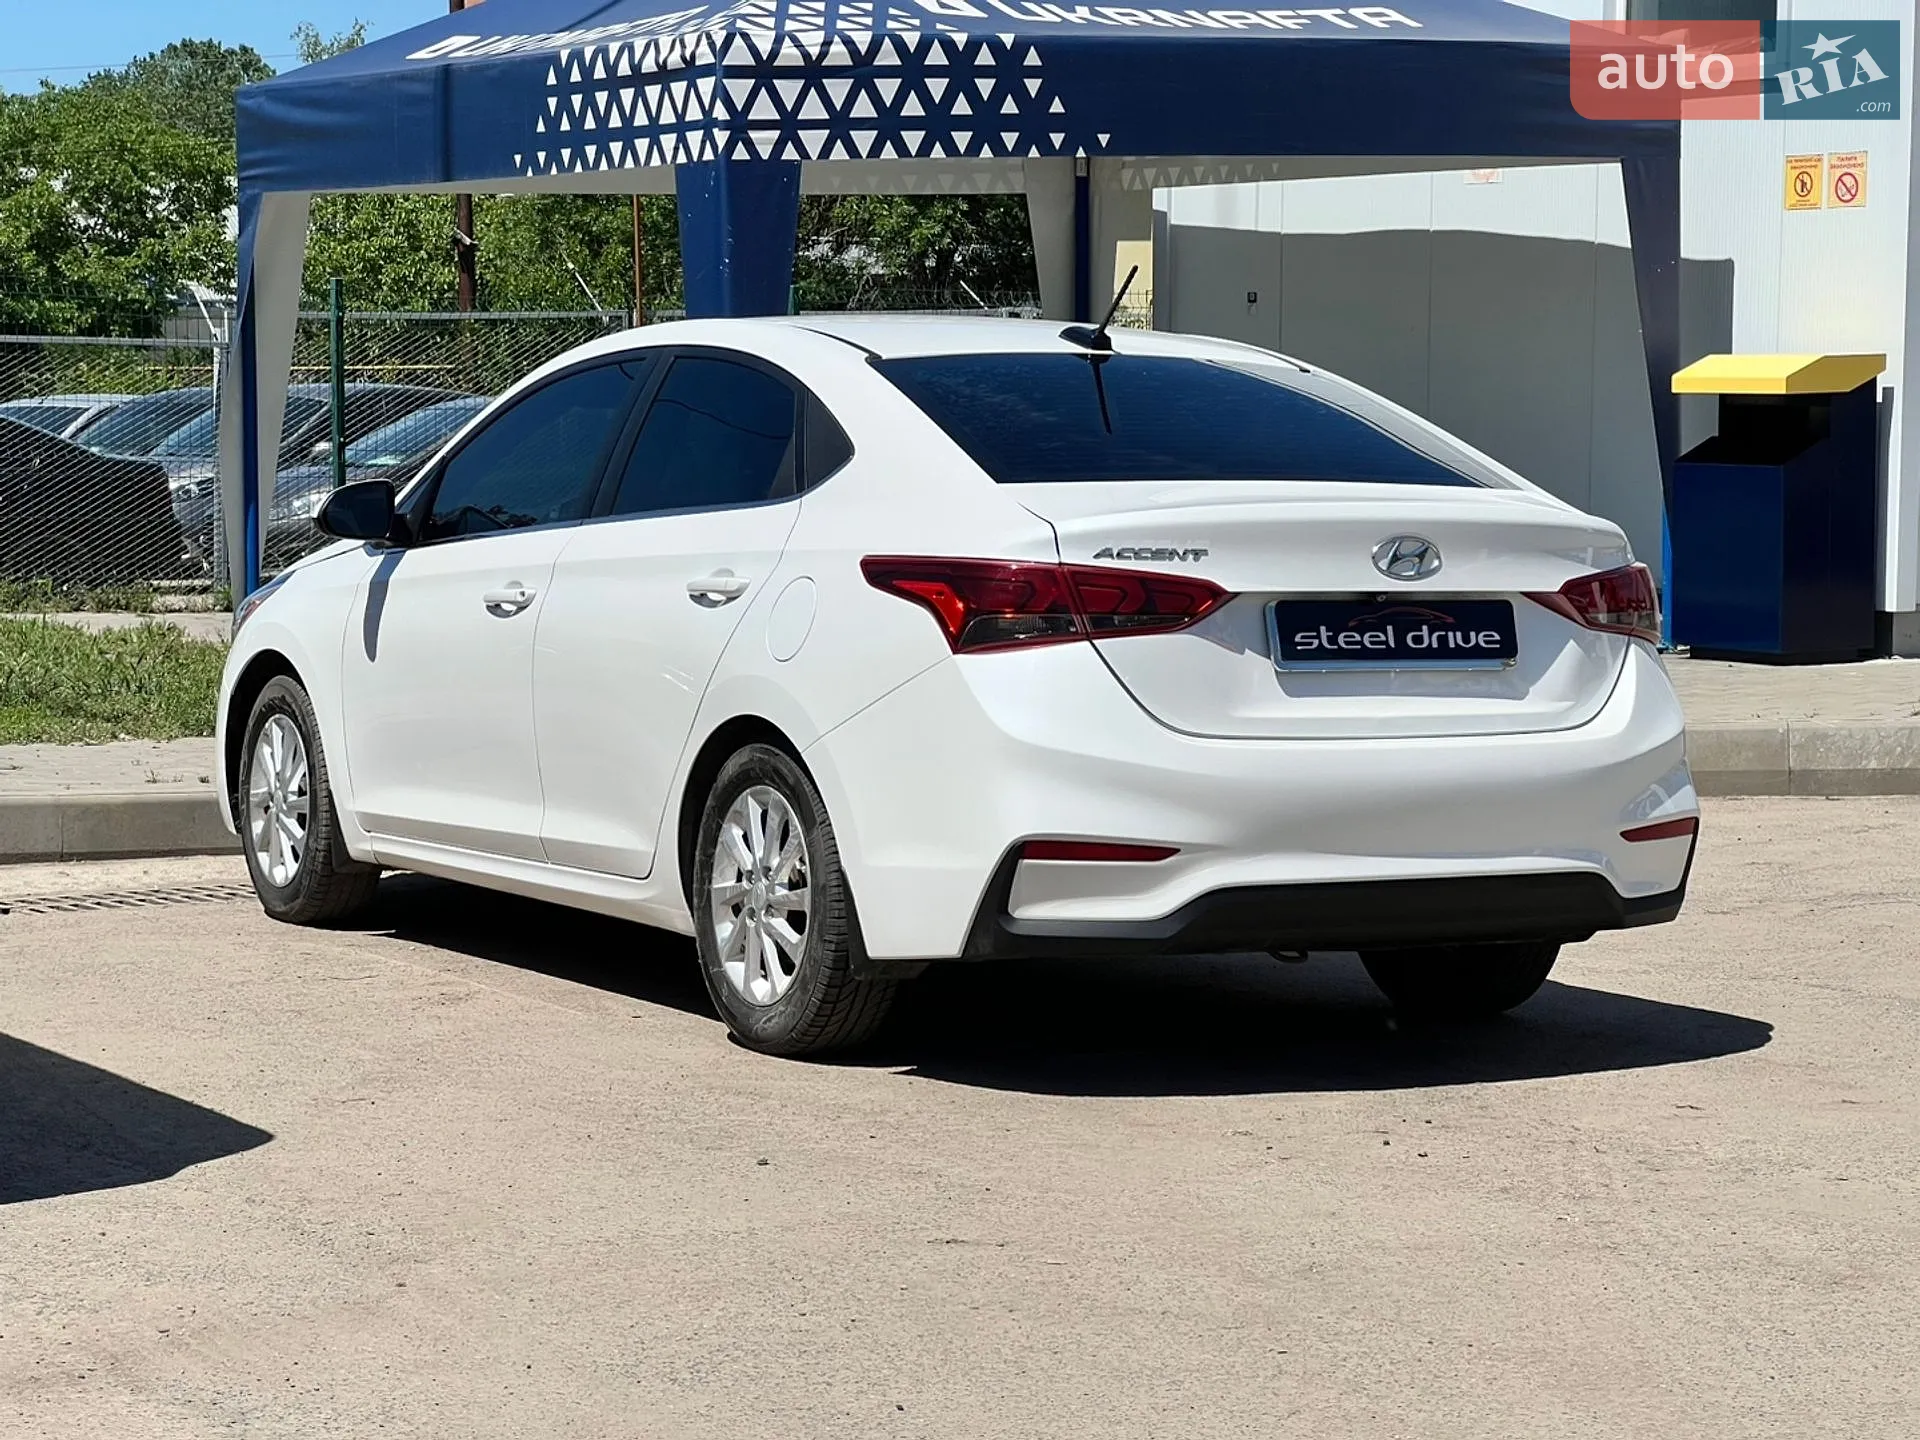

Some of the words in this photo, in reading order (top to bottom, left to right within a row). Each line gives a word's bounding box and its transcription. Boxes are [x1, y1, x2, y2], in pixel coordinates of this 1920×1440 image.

[986, 0, 1424, 29] UKRNAFTA
[1092, 547, 1209, 562] ACCENT
[1294, 625, 1395, 650] steel
[1406, 625, 1501, 649] drive
